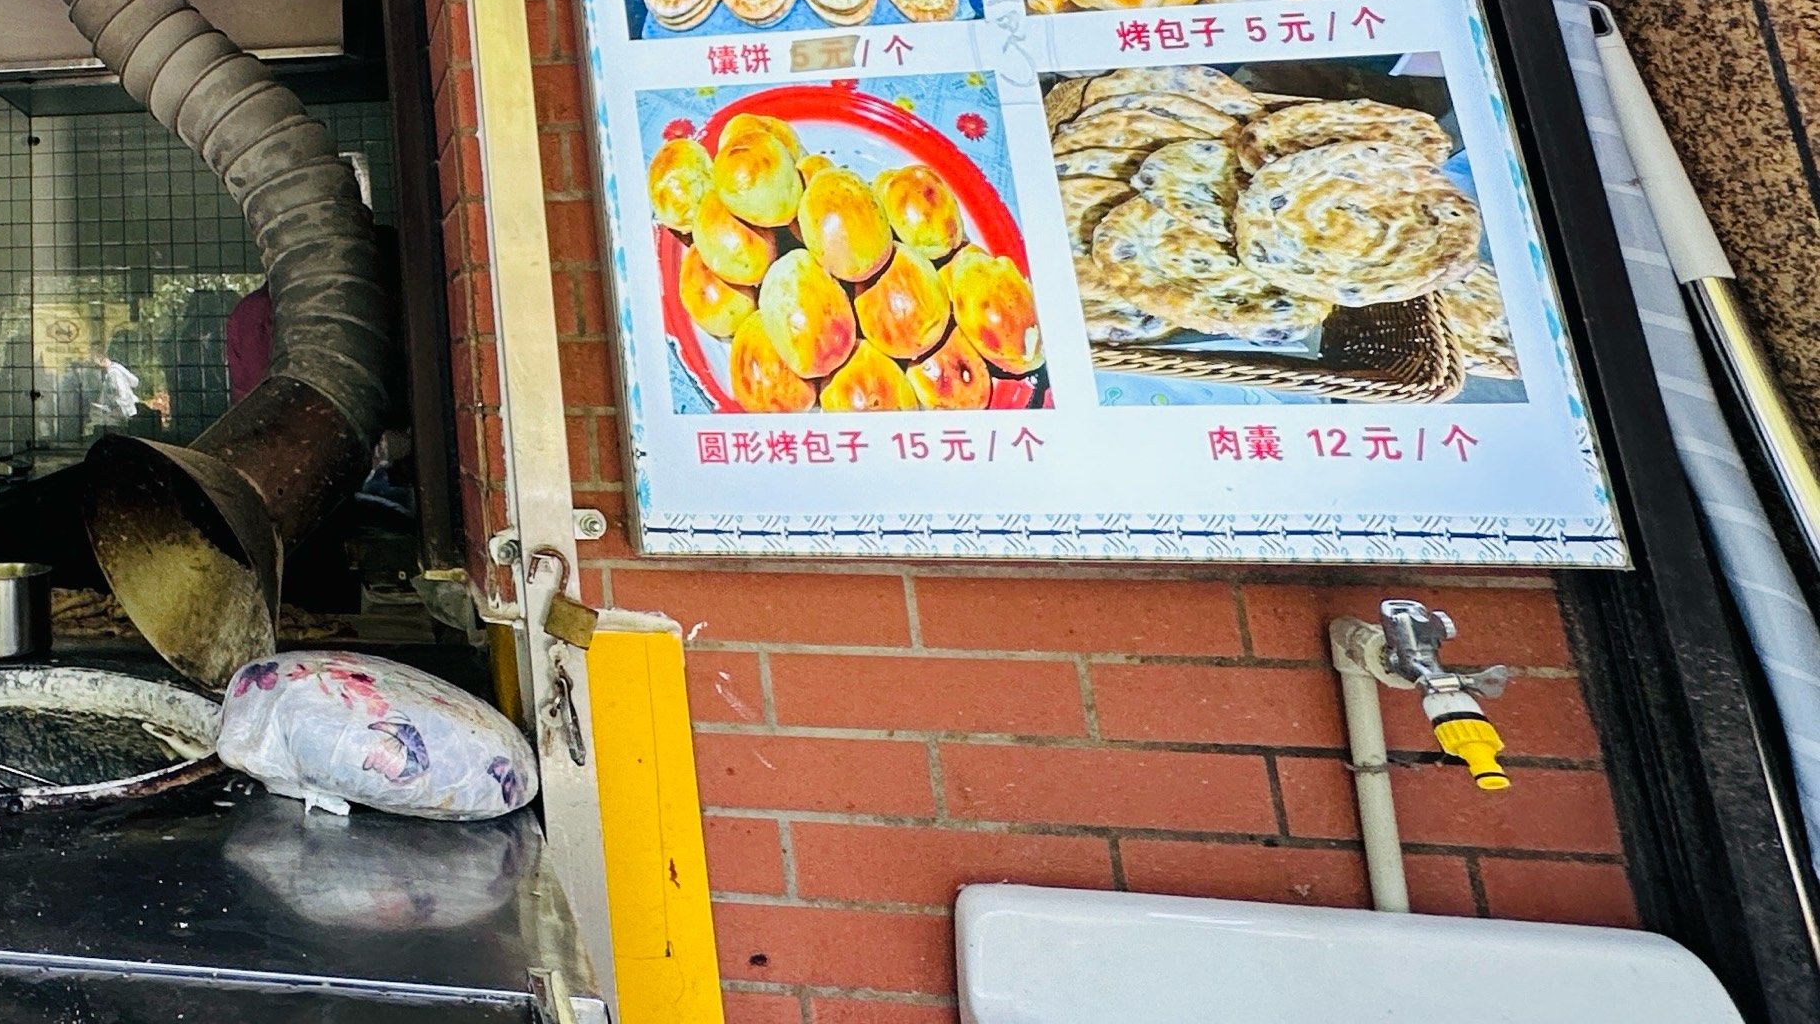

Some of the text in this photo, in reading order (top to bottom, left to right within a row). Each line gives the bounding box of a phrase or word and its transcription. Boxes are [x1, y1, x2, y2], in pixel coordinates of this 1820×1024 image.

[1116, 16, 1225, 52] 烤包子
[707, 43, 772, 75] 馕饼
[696, 430, 870, 465] 圆形烤包子
[1208, 424, 1284, 461] 肉囊
